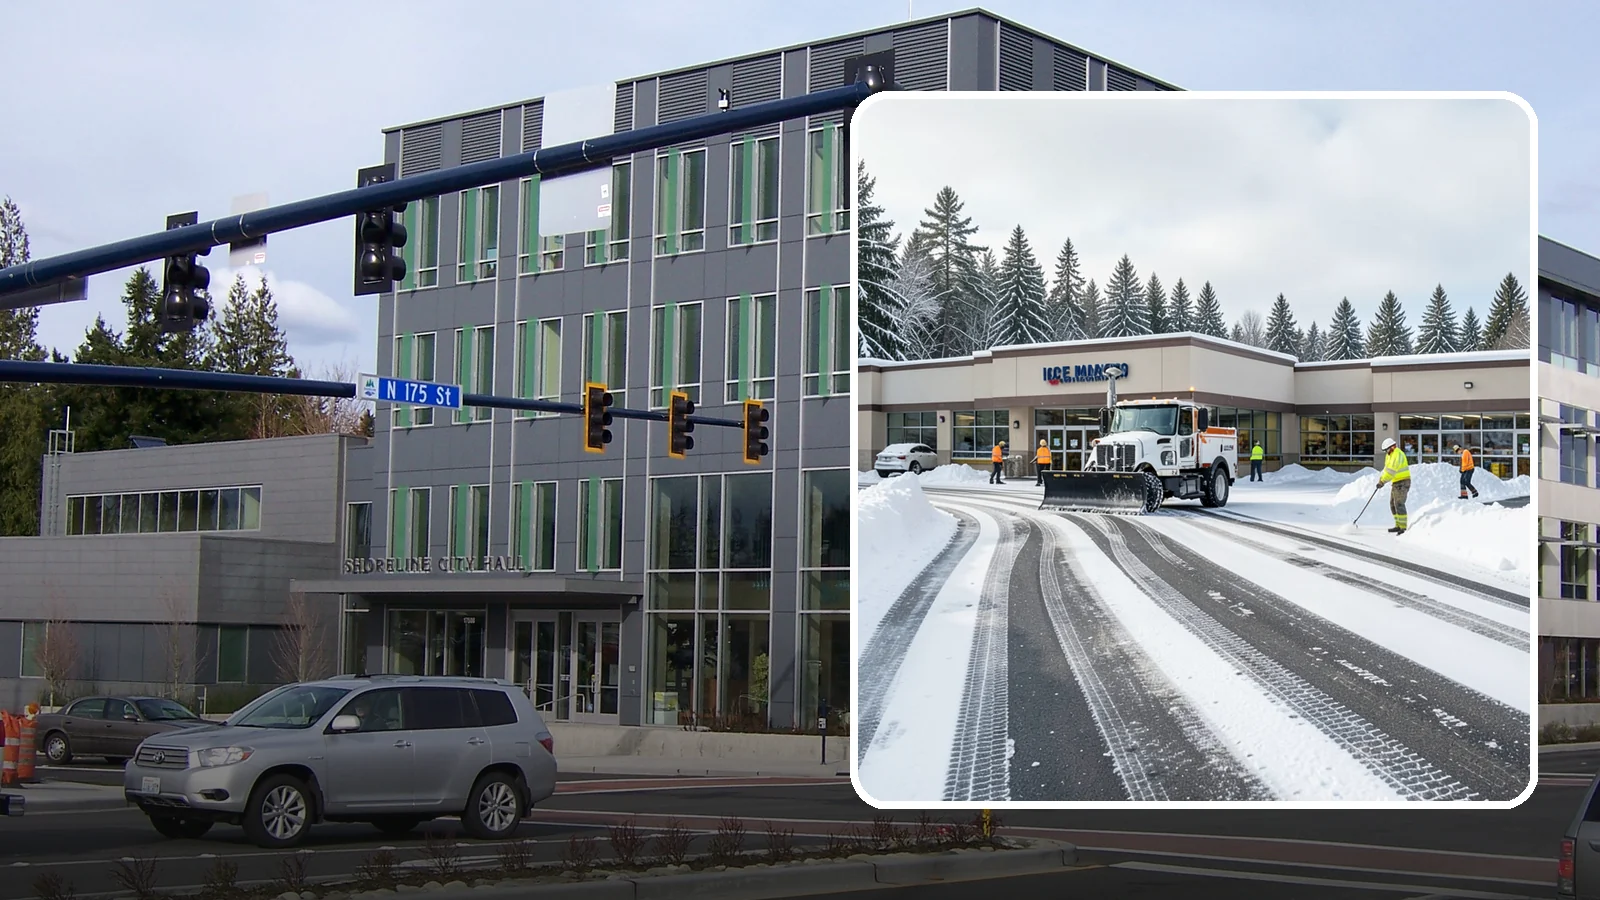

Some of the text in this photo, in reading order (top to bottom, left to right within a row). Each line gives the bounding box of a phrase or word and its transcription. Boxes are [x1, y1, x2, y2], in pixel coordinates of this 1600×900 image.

[387, 380, 451, 406] N 175 St
[344, 555, 525, 574] SHORELINE CITY HALL
